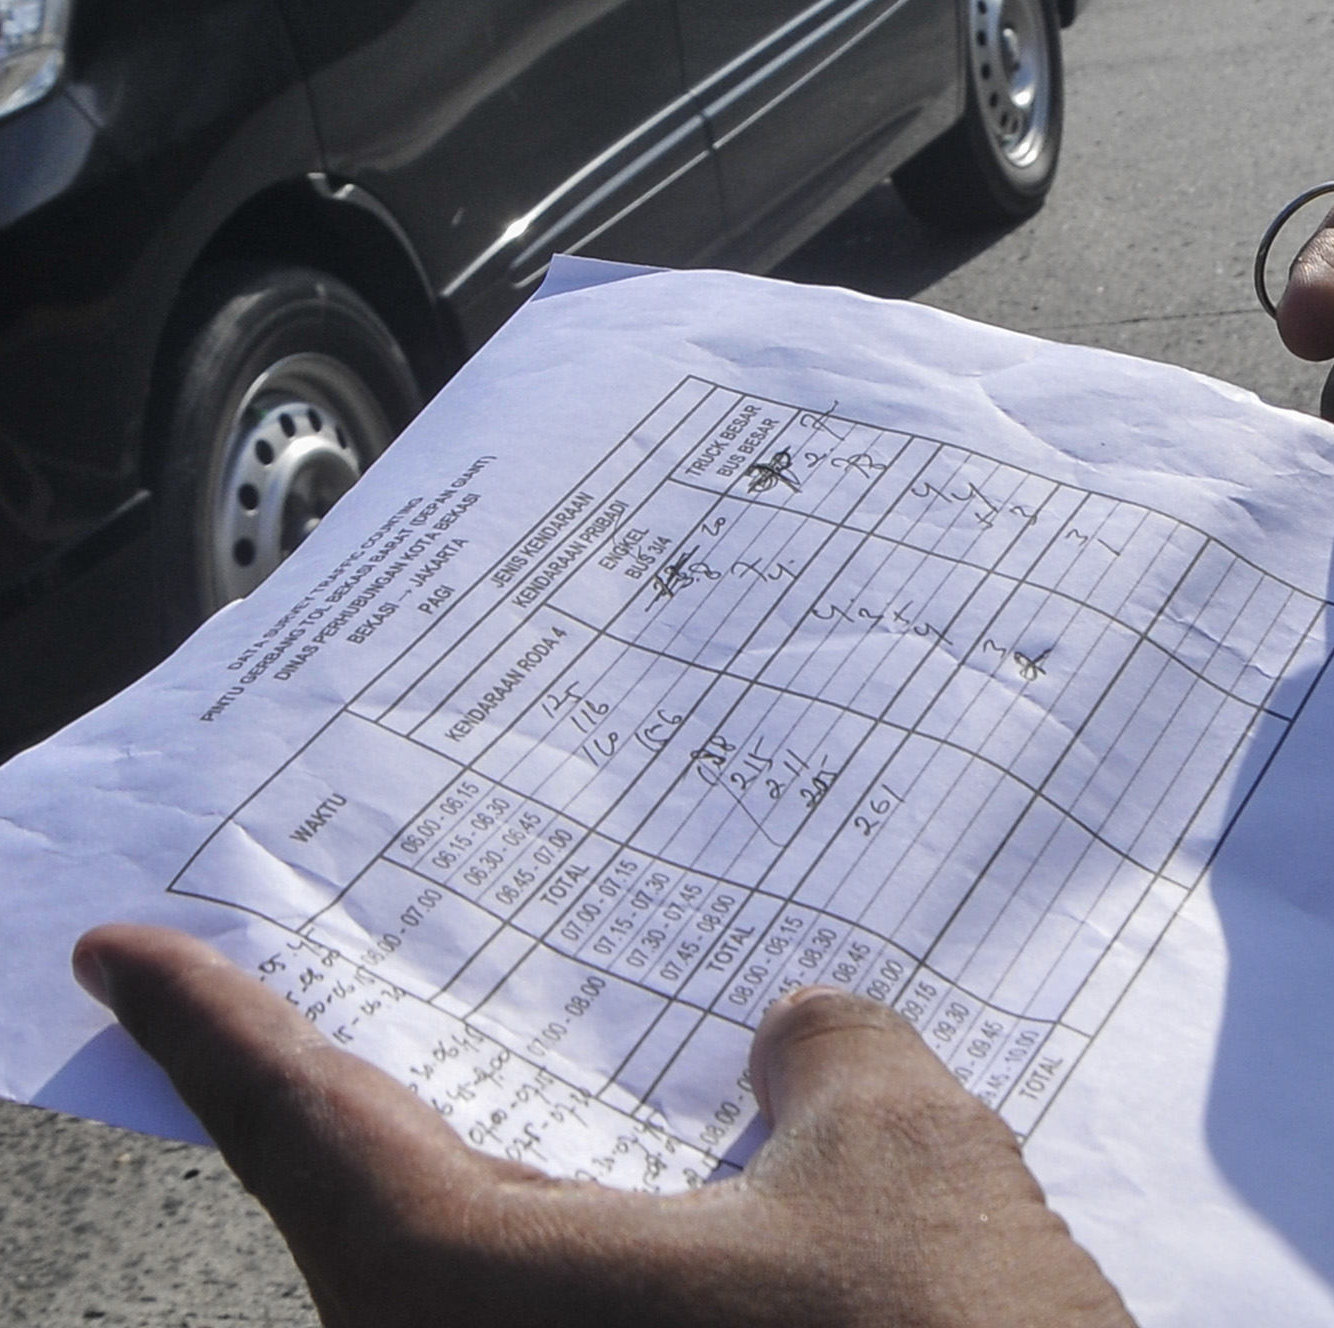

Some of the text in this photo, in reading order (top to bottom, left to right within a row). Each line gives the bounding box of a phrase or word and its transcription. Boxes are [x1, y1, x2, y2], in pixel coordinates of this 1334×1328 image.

[685, 404, 762, 478] TRUCK BESAR
[716, 454, 746, 478] BUS
[738, 418, 780, 455] BESAR
[490, 491, 595, 589] JENIS KENDARAAN
[512, 541, 588, 609] KENDARAAN
[579, 499, 630, 544] PRIBADI
[598, 528, 650, 571] ENGKEL
[624, 552, 657, 580] BUS
[648, 535, 673, 556] 3/4
[200, 455, 498, 723] PINTU GERBANG TOL BEKASI BARAT (DEPAN GIANT)
[227, 496, 424, 671] DATA SURVEY TRAFFIC COUNTING
[273, 493, 482, 682] DINAS PERHUBUNGAN KOTA BEKASI
[347, 538, 470, 646] BEKASI JAKARTA
[418, 584, 456, 615] PAGI
[444, 626, 567, 743] KENDARAAN RODA 4
[541, 681, 583, 720] 125
[730, 736, 773, 790] 215
[765, 748, 810, 800] 211
[289, 793, 347, 843] WAKTU
[400, 818, 441, 855] 06.00
[439, 781, 480, 816] 06.15
[432, 834, 473, 870] 06.15
[471, 797, 511, 832] 06.30
[854, 783, 905, 837] 261
[463, 850, 504, 887] 06.30
[501, 811, 542, 847] 06.45
[495, 868, 536, 906] 06.45
[533, 828, 573, 866] 07.00
[400, 888, 443, 928] 07.00
[539, 863, 590, 907] TOTAL
[560, 903, 601, 941] 07.00
[599, 859, 639, 898] 07.15
[593, 917, 634, 956] 07.15
[630, 872, 671, 911] 07.30
[626, 929, 667, 968] 07.30
[663, 883, 703, 922] 07.45
[659, 940, 700, 982] 07.45
[696, 894, 736, 934] 08.00
[705, 925, 756, 973] TOTAL
[728, 964, 769, 1006] 08.00
[765, 915, 805, 956] 08.15
[798, 927, 838, 970] 08.30
[832, 940, 871, 984] 08.45
[564, 975, 606, 1017] 08.00
[866, 958, 905, 1002] 09.00
[900, 981, 937, 1022] 09.15
[933, 1001, 970, 1043] 09.30
[967, 1020, 1005, 1059] 09.45
[1019, 1056, 1064, 1101] TOTAL
